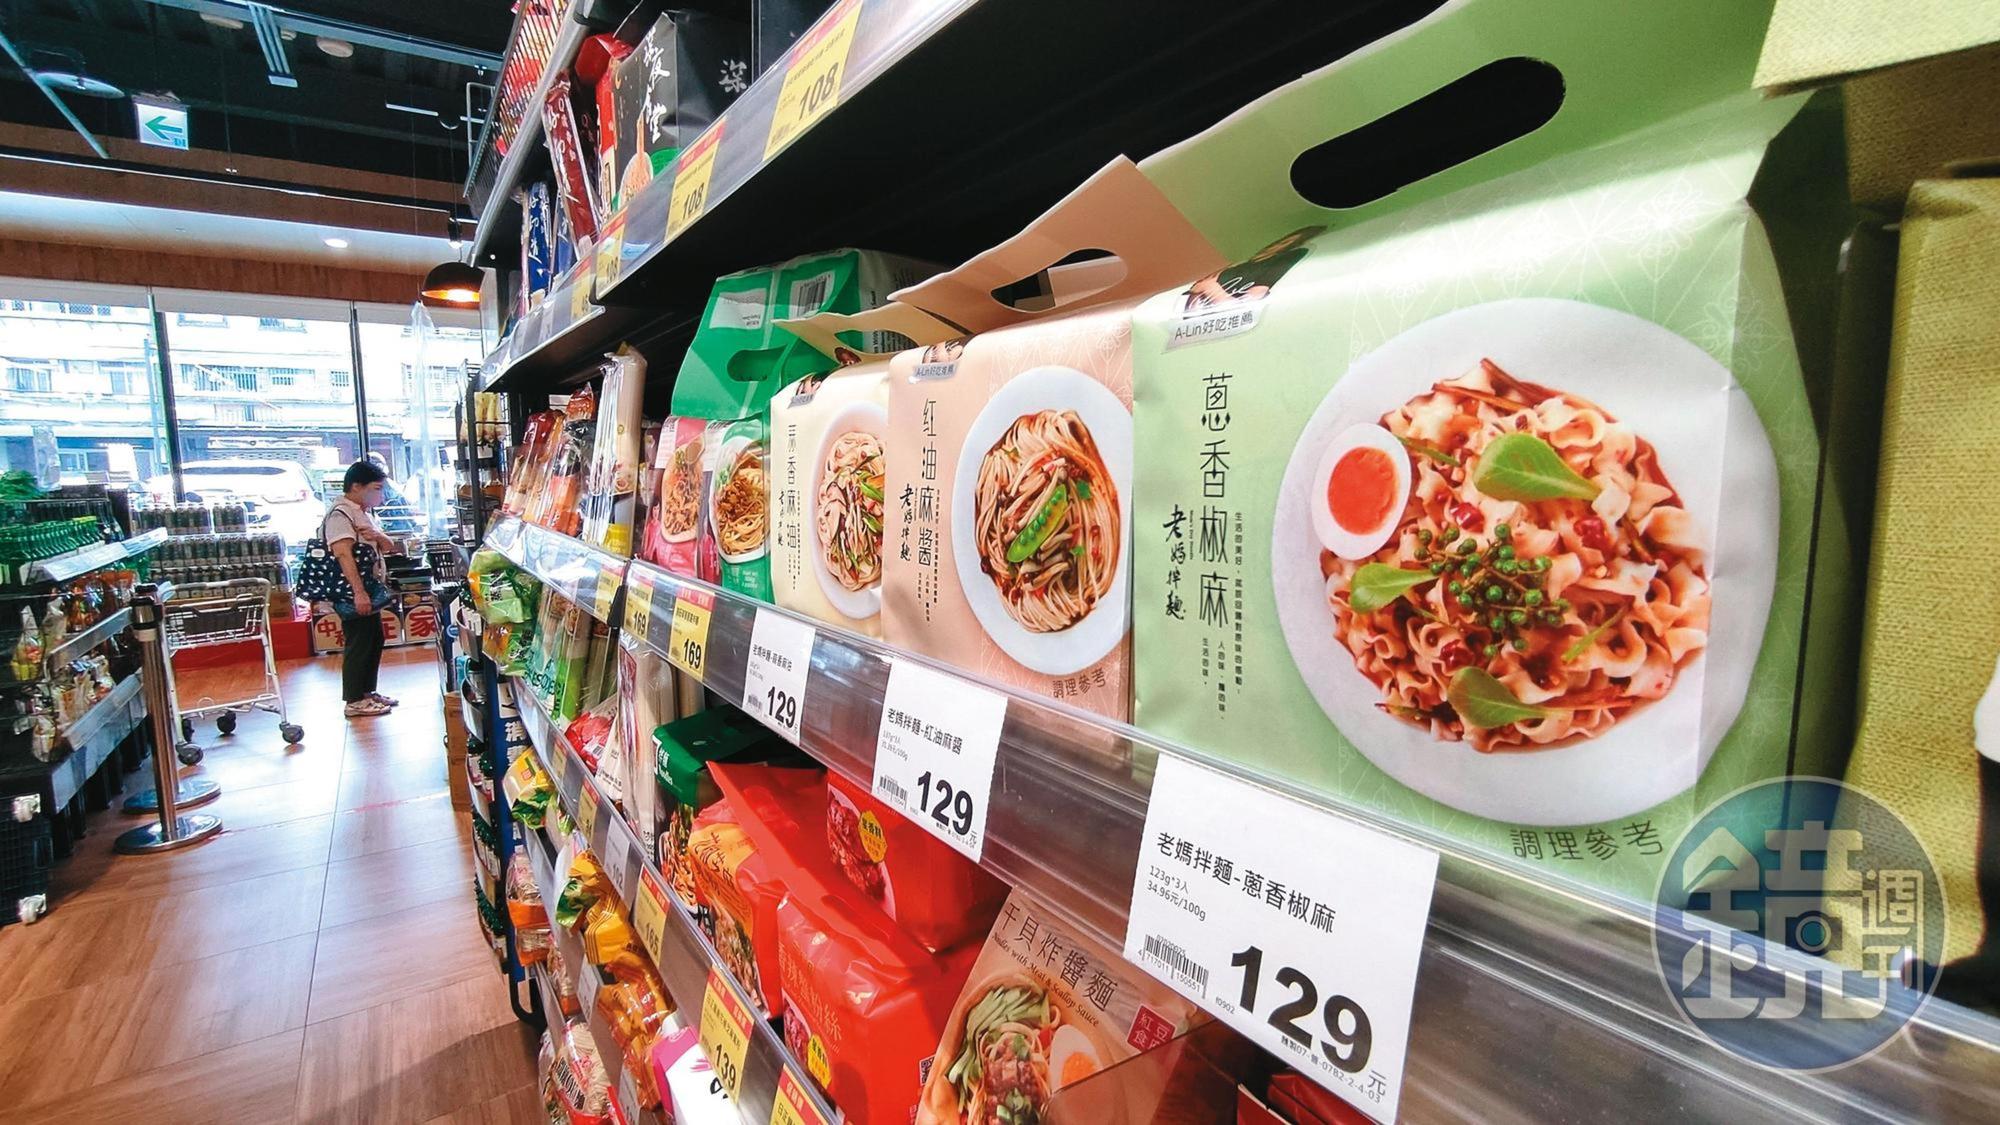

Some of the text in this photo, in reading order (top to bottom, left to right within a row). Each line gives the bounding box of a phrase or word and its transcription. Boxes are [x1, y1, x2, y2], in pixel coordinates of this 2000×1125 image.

[719, 59, 748, 93] 深
[799, 61, 839, 120] 108
[682, 182, 705, 220] 108
[409, 610, 436, 637] 家
[683, 638, 702, 670] 169
[1051, 668, 1106, 699] 調理參考
[767, 686, 797, 729] 129
[917, 770, 974, 836] 129
[1509, 818, 1664, 861] 調理參考
[1146, 879, 1207, 922] 34.96元/100g
[1010, 950, 1029, 966] with
[1027, 963, 1047, 983] Meat
[1051, 984, 1077, 1009] Scallop
[1076, 1004, 1099, 1026] Sauce
[1230, 945, 1388, 1097] 129 元
[714, 1043, 737, 1090] 139
